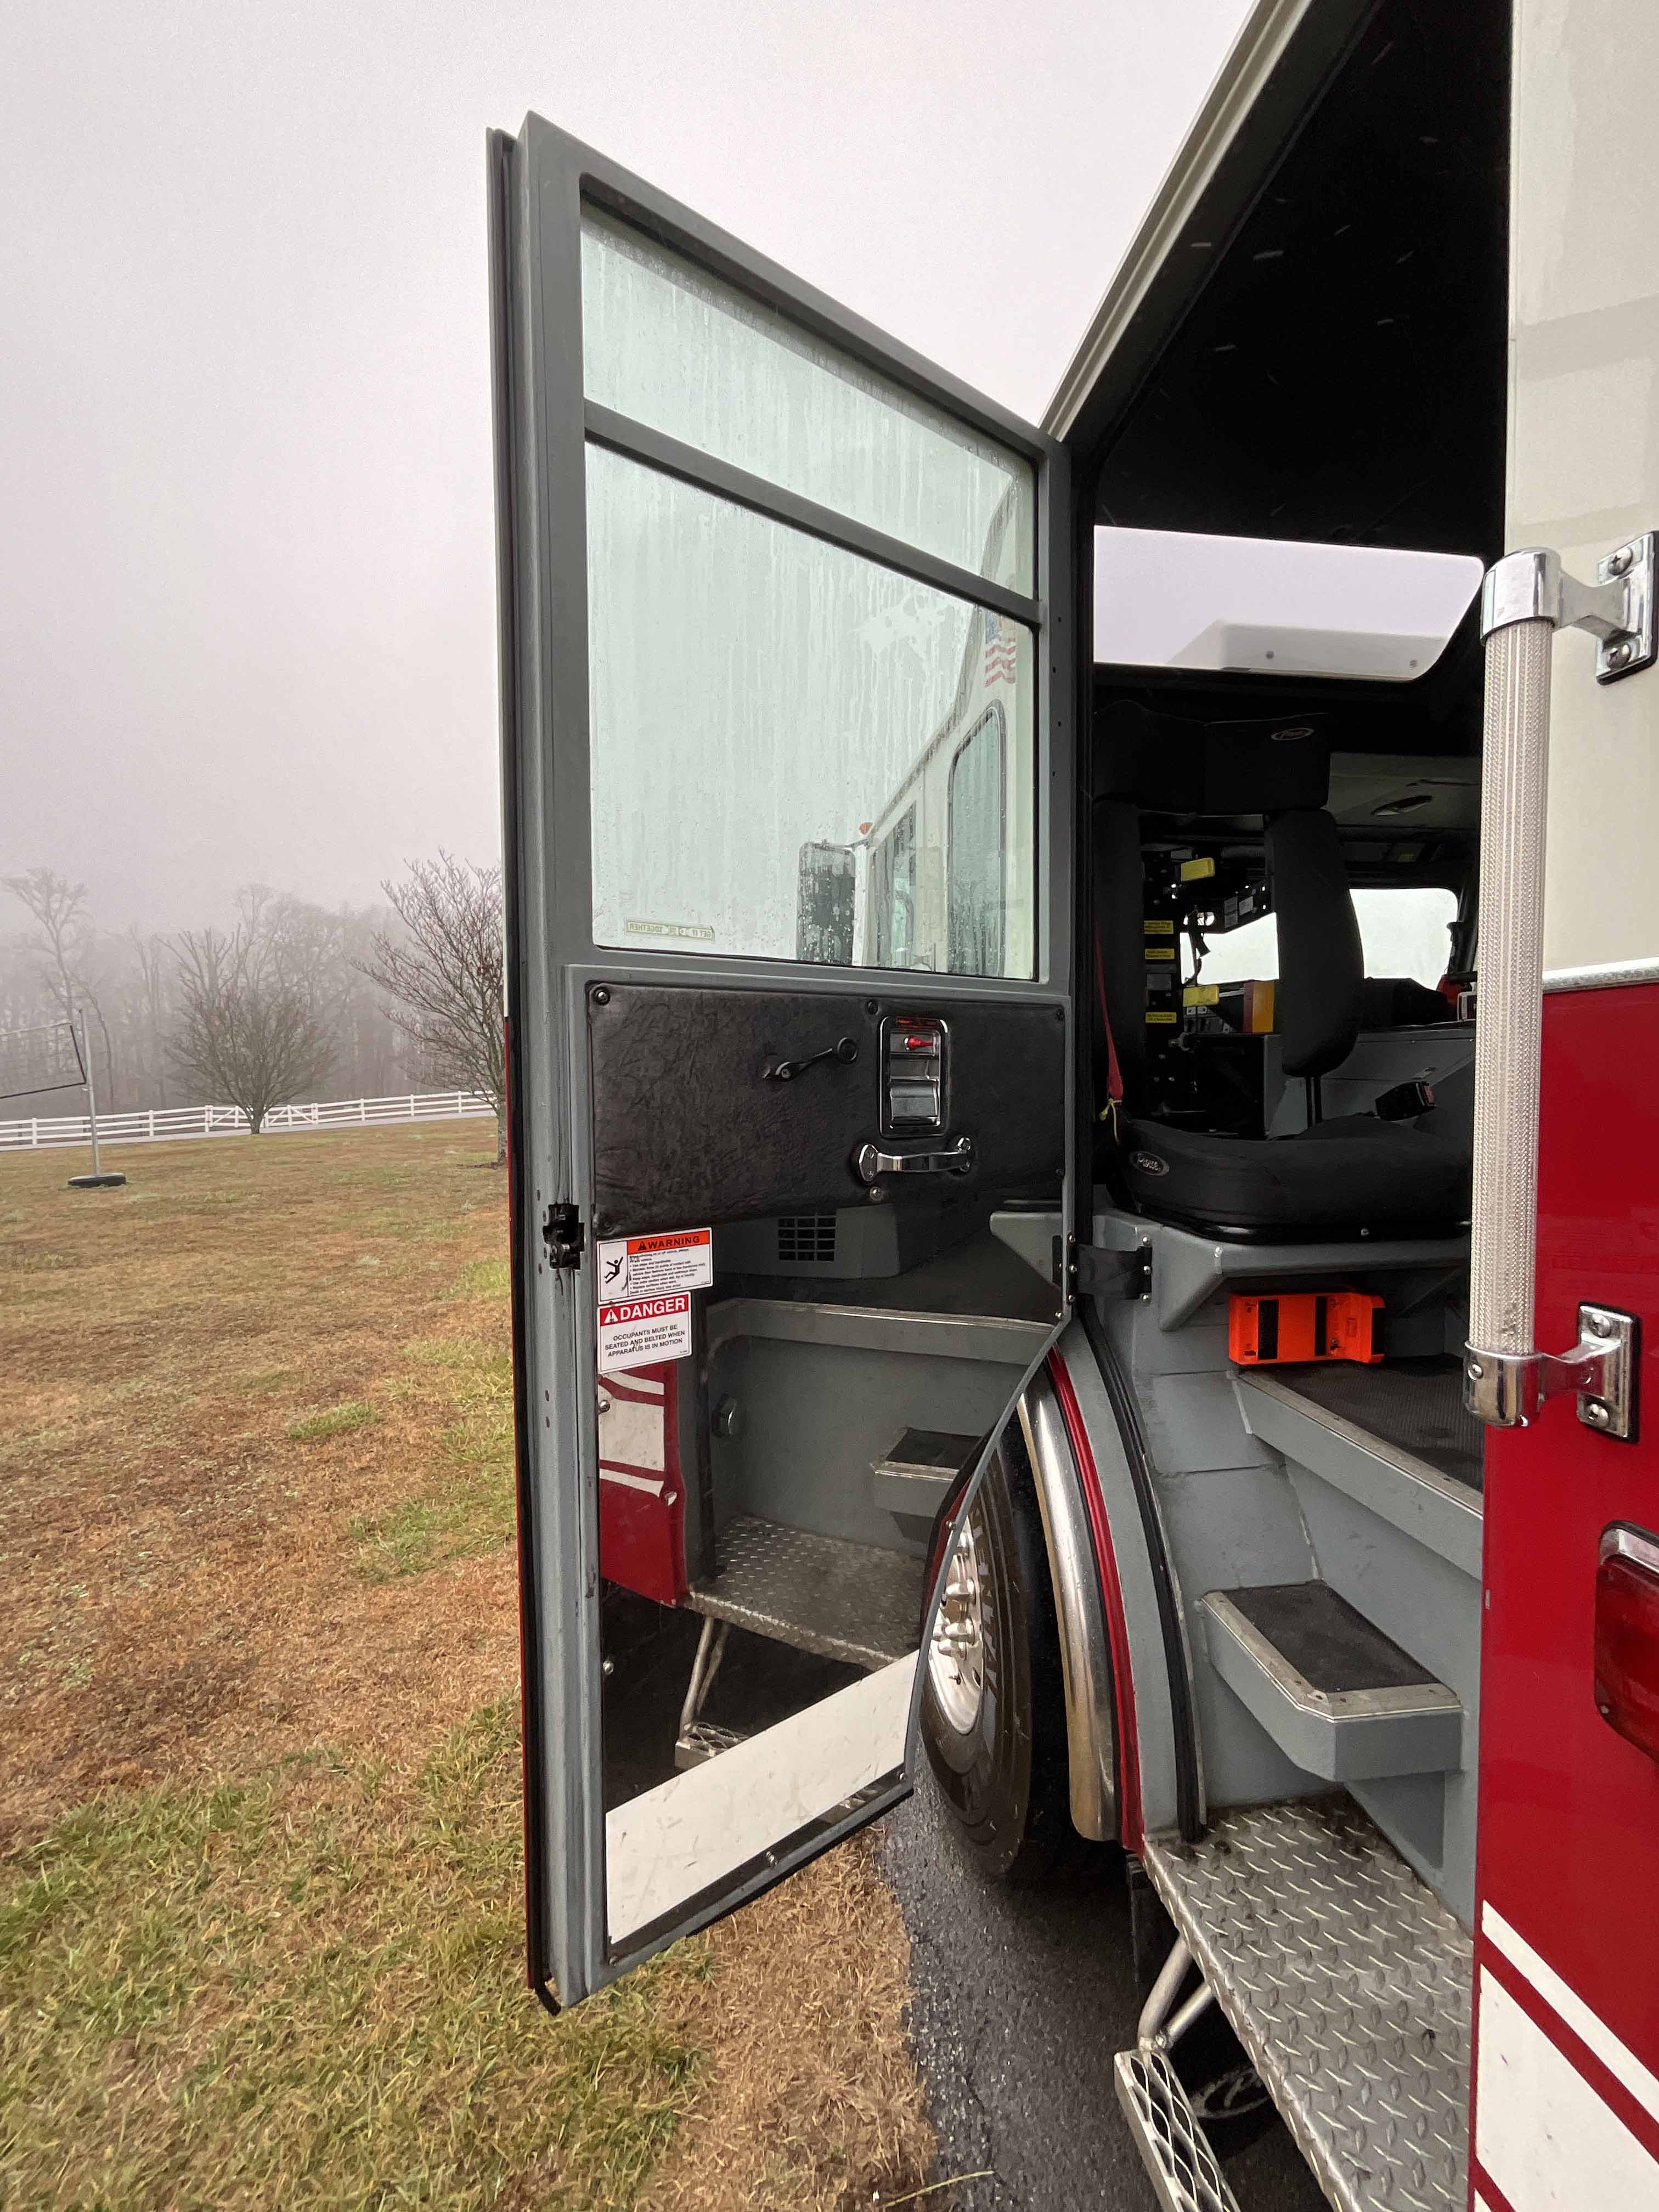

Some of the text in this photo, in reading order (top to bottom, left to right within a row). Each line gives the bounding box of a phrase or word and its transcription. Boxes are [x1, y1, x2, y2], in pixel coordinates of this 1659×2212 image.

[648, 1236, 700, 1249] WARNING
[620, 1297, 685, 1321] DANGER
[605, 1341, 629, 1350] SEATED
[645, 1334, 666, 1342] BELTED
[668, 1330, 685, 1338] WHEN
[613, 1329, 650, 1341] OCCUPANTS
[608, 1345, 644, 1357] APPARATUS
[659, 1338, 682, 1347] MOTION
